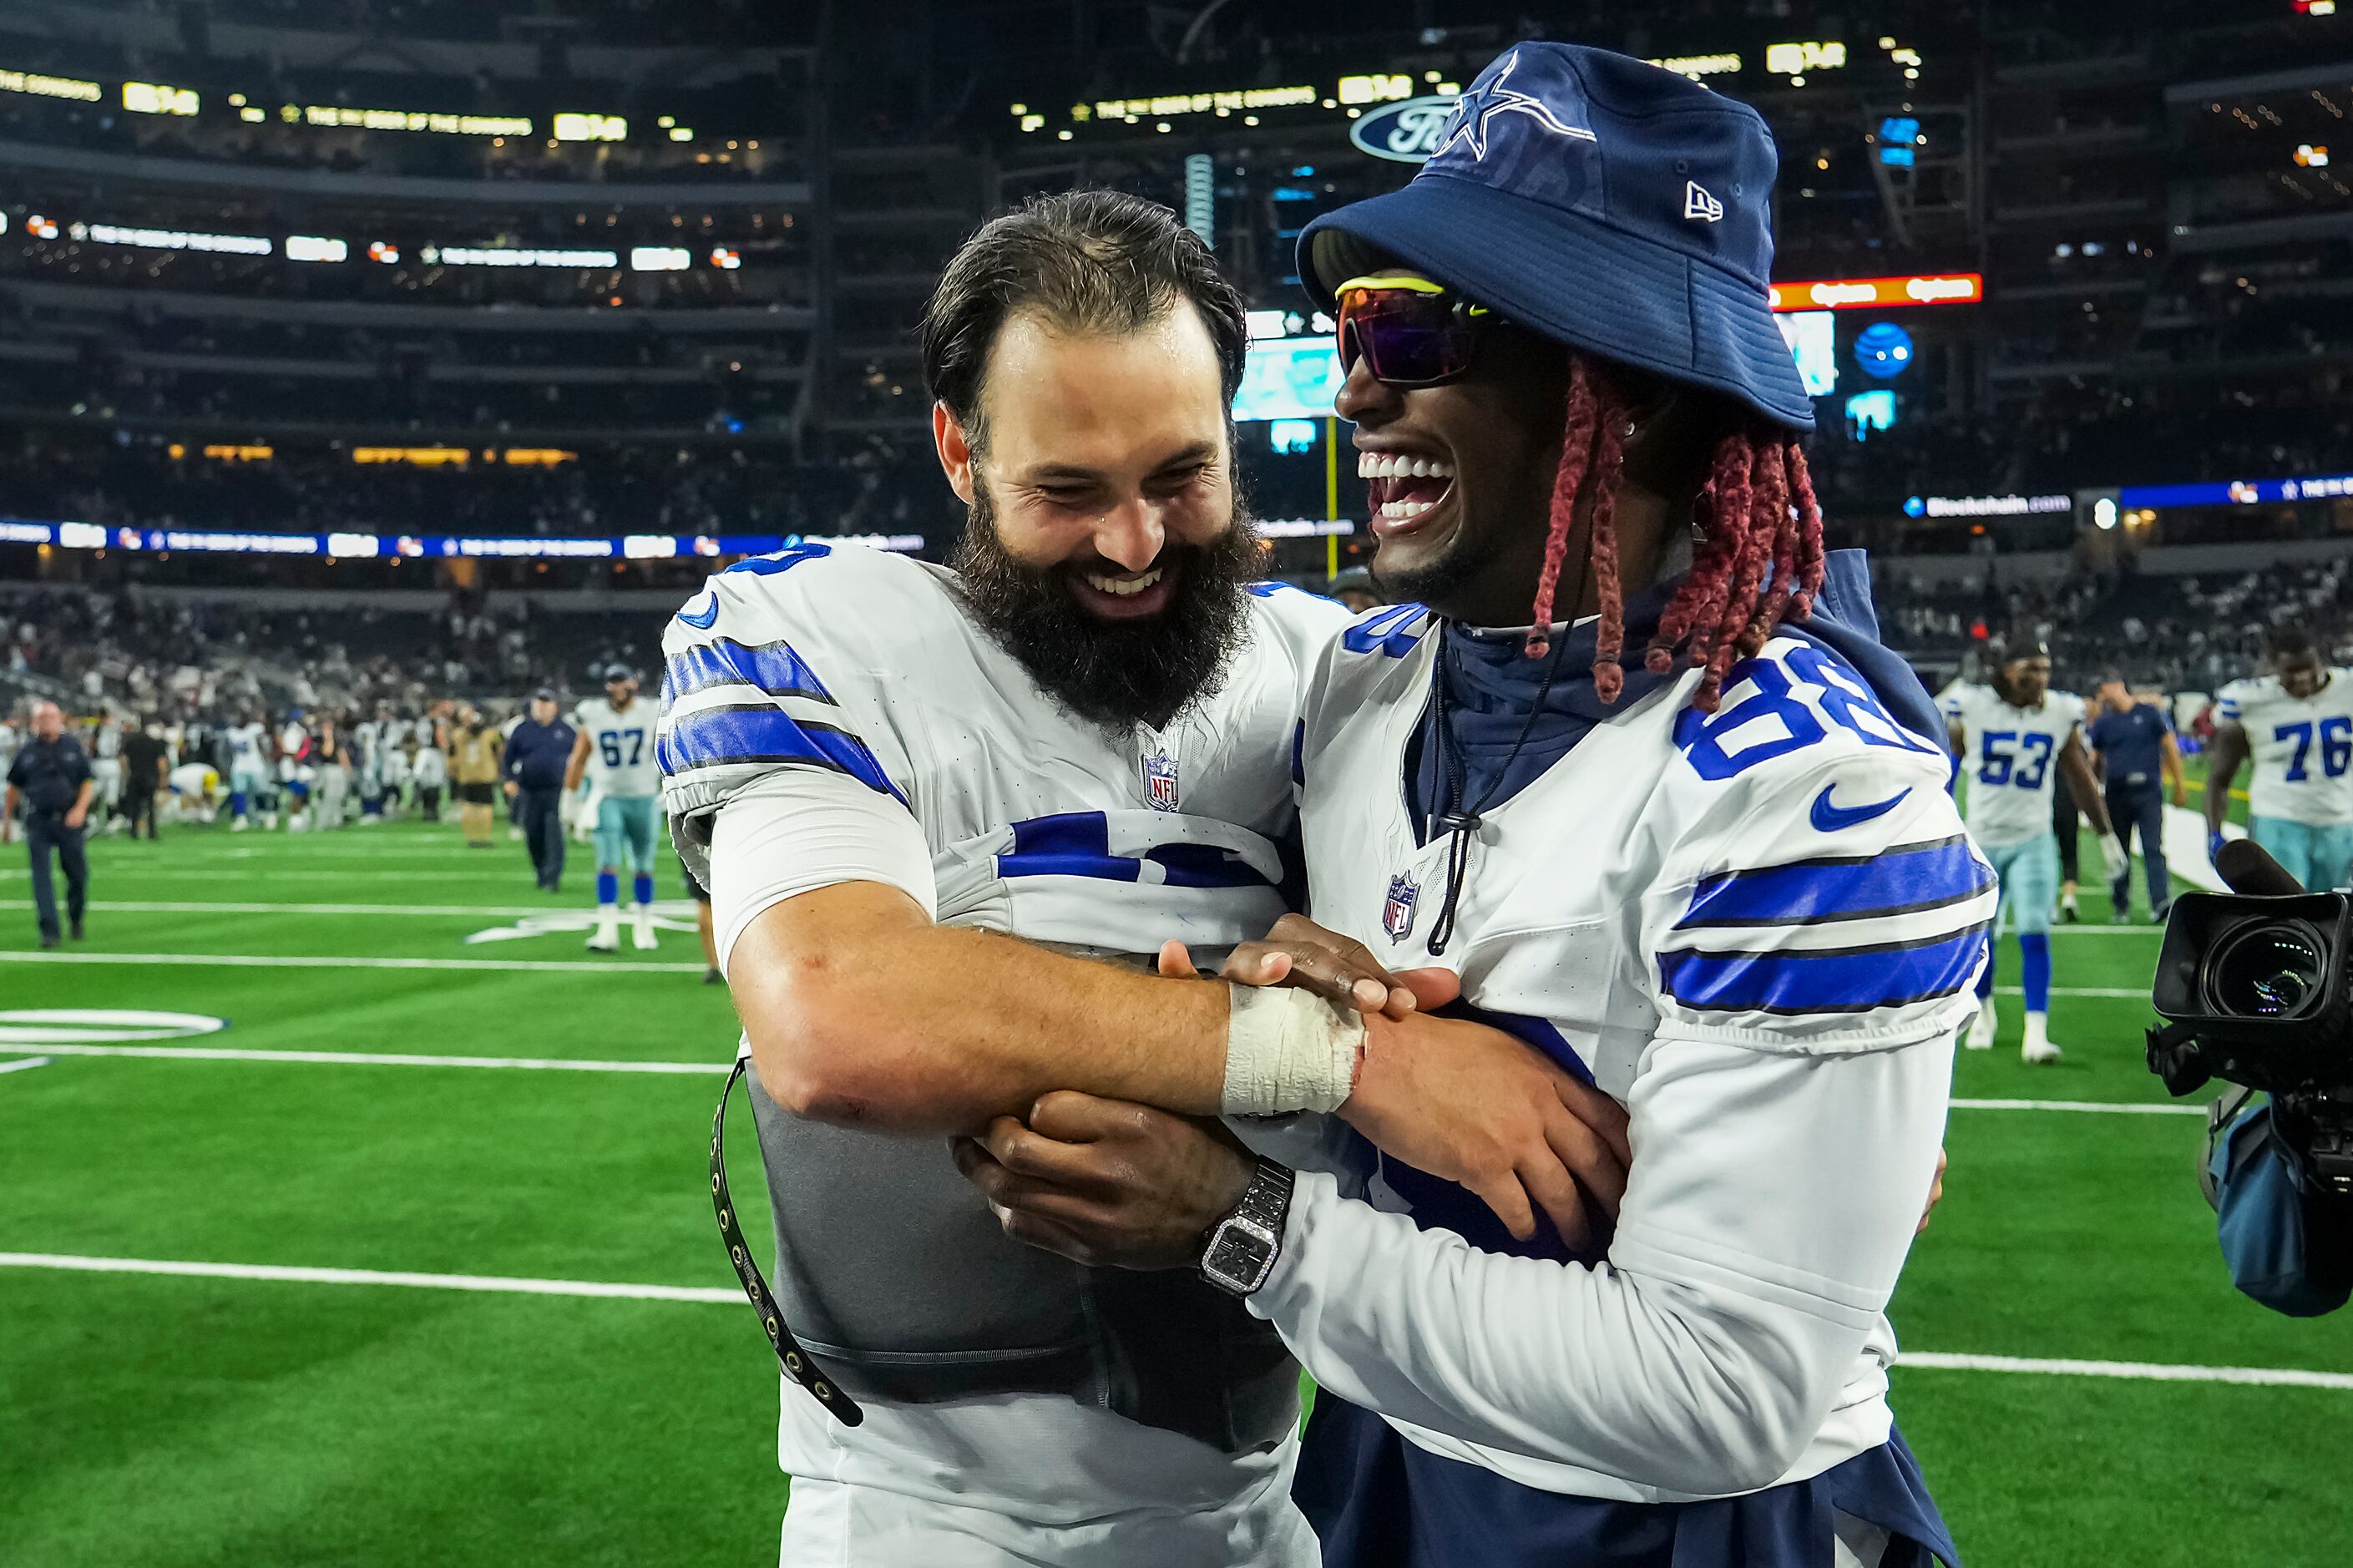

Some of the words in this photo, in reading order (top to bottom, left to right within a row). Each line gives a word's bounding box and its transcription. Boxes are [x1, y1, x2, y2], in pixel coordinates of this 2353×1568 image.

[1672, 646, 1940, 781] 88
[600, 727, 644, 766] 67
[1980, 731, 2053, 789] 53
[2275, 716, 2352, 782] 76
[1151, 777, 1177, 802] NFL
[1385, 900, 1406, 932] NFL
